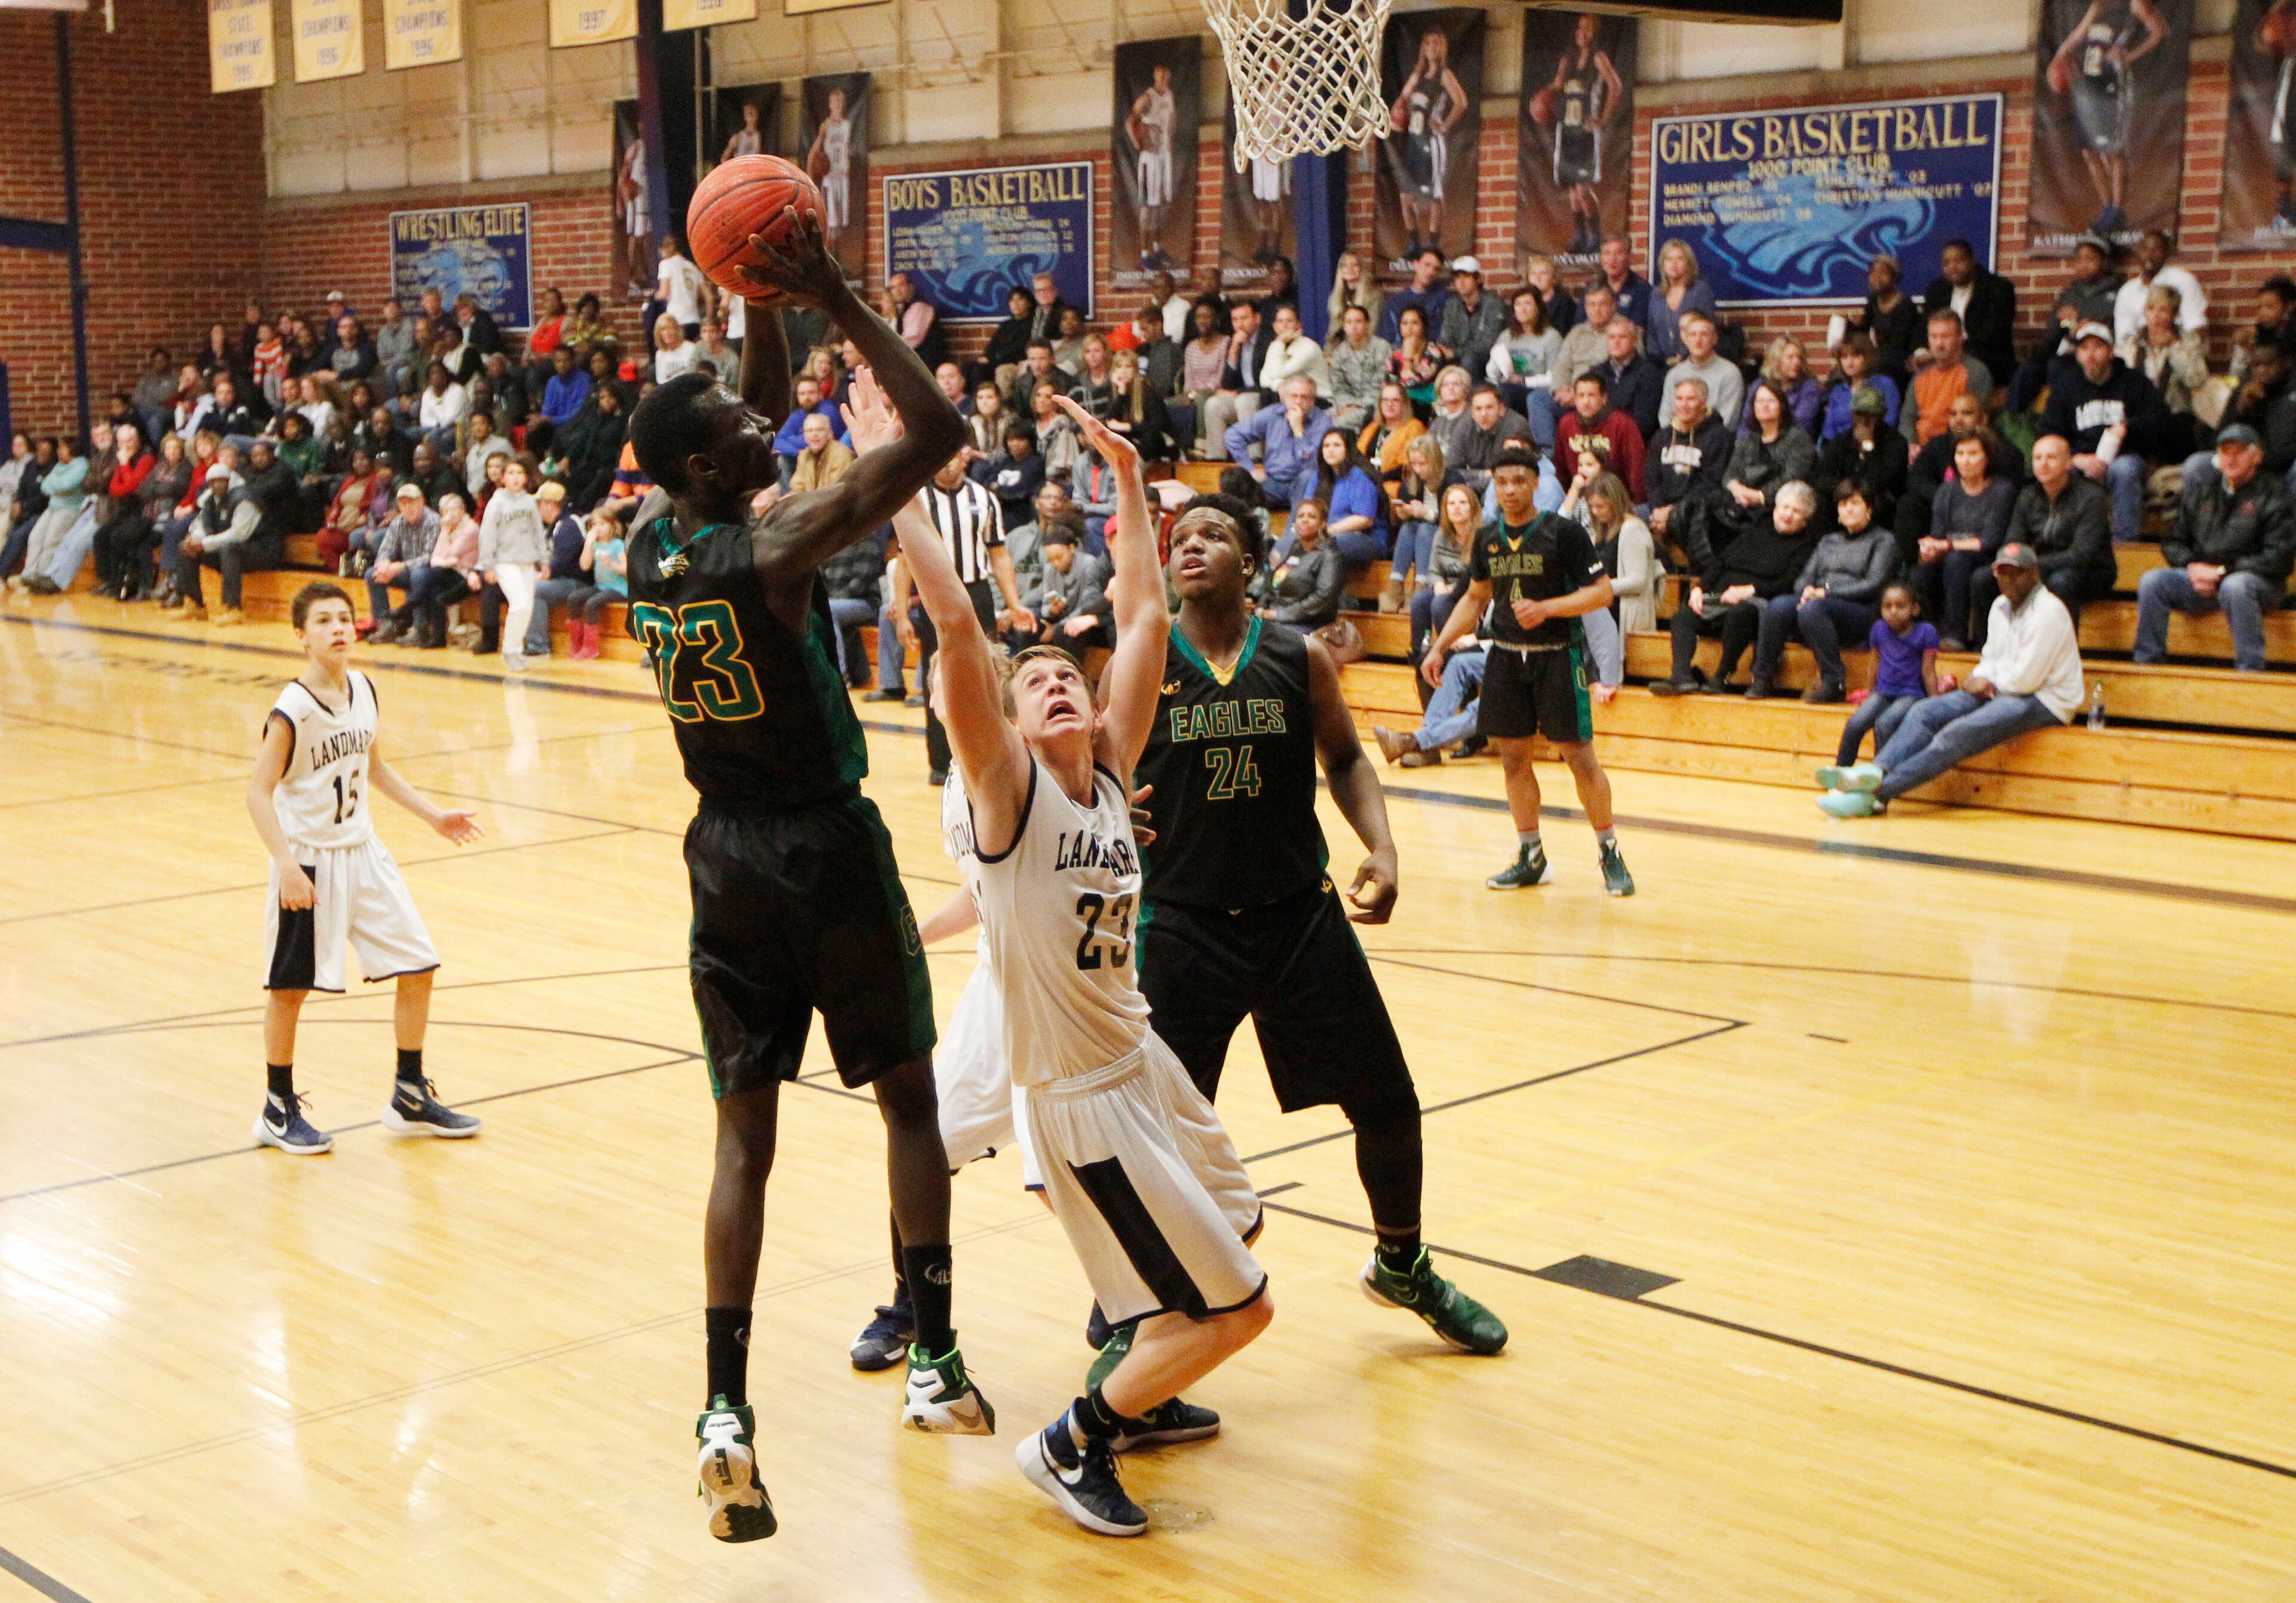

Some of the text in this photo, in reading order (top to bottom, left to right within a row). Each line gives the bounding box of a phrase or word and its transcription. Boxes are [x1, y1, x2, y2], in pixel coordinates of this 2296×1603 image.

[1659, 102, 1989, 164] GIRLS BASKETBALL
[1748, 152, 1892, 179] 1000 POINT CLUB
[889, 168, 1085, 210] BOYS BASKETBALL
[396, 208, 526, 240] WRESTLING ELITE
[1488, 554, 1544, 578] EAGLES
[633, 599, 765, 723] 23
[1170, 699, 1286, 742] EAGLES
[310, 728, 374, 771] LANDMA
[1205, 745, 1262, 800] 24
[333, 769, 359, 825] 15
[1076, 892, 1133, 970] 23
